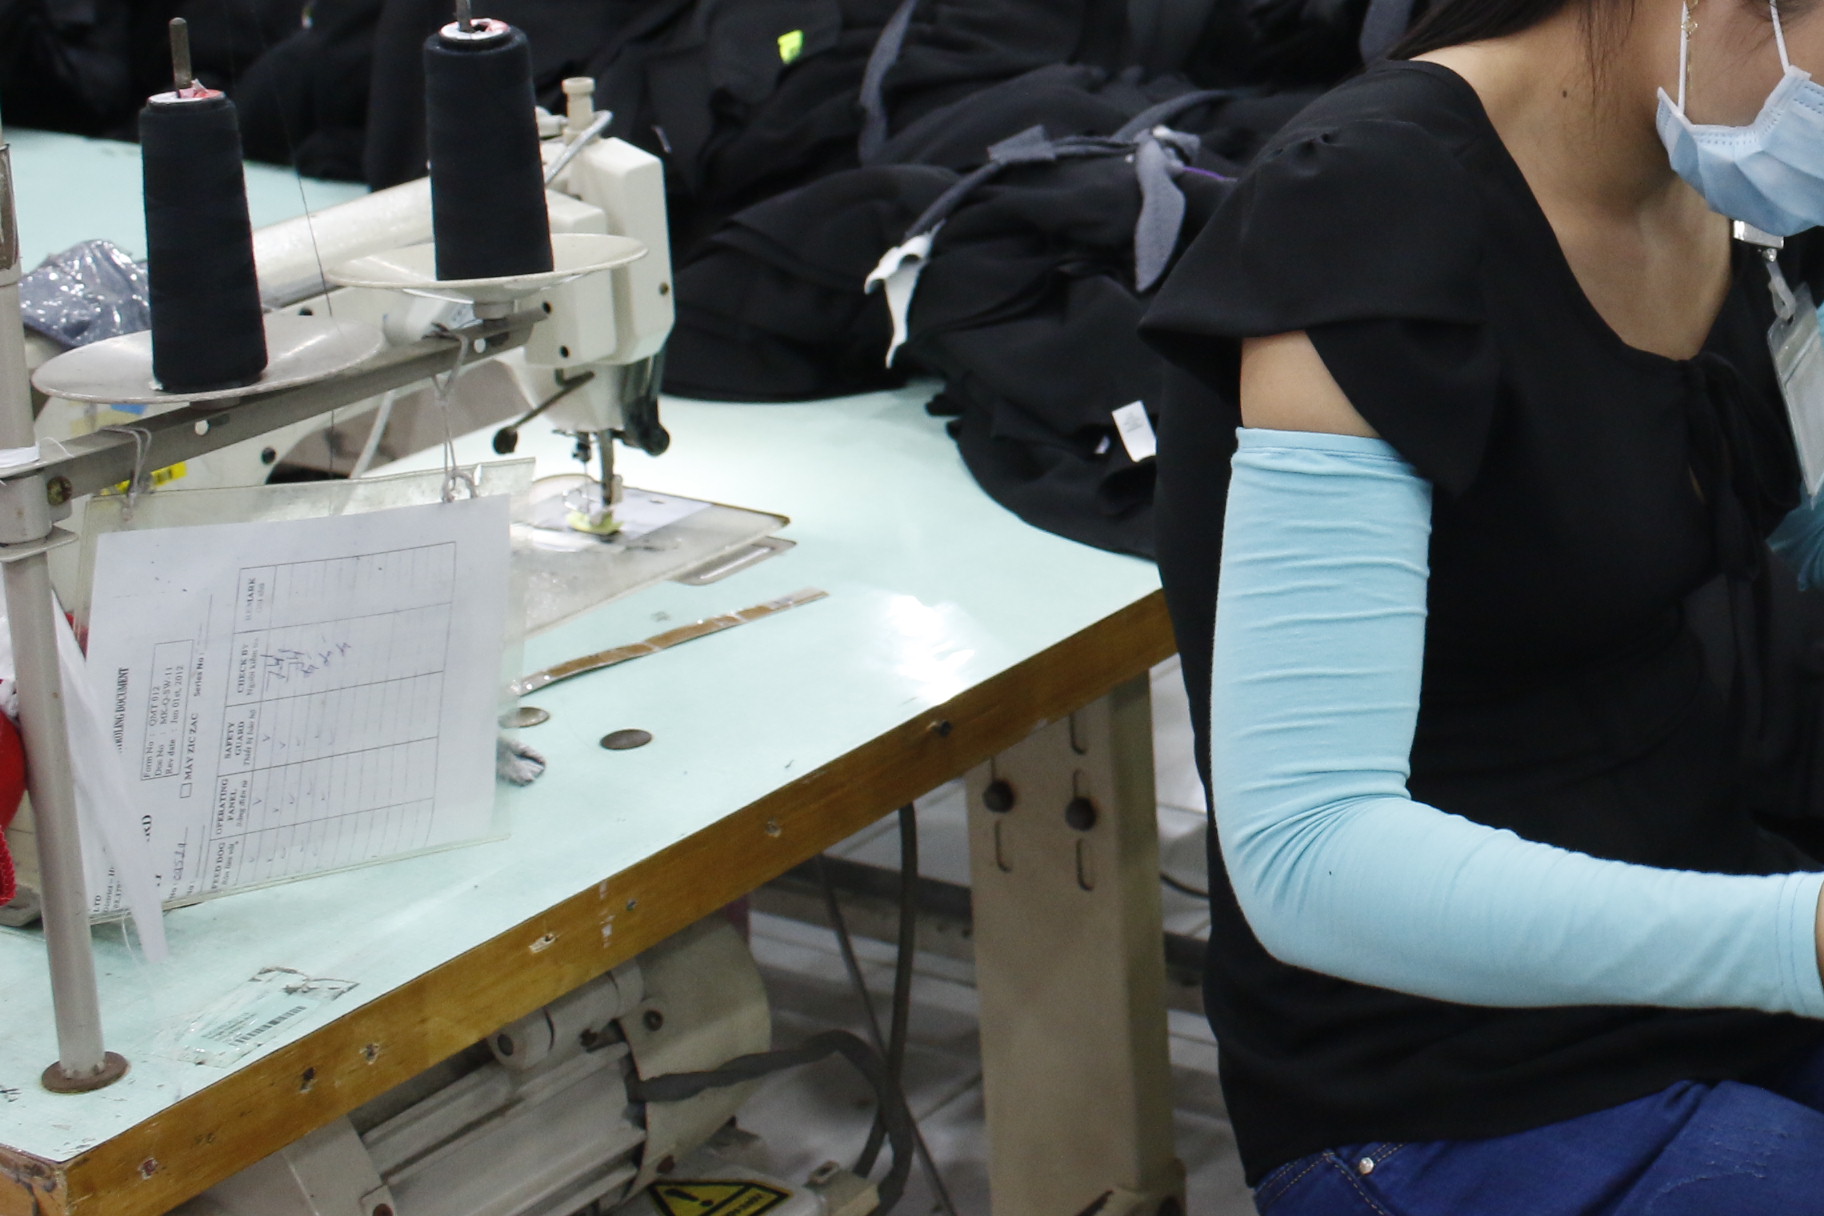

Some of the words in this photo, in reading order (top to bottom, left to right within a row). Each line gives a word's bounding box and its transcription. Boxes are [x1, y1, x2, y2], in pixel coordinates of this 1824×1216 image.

[196, 657, 204, 670] No
[175, 666, 184, 686] 2012
[193, 672, 203, 698] Series
[237, 658, 248, 694] CHECK
[115, 668, 129, 714] DOCUMENT
[148, 705, 159, 727] QMT
[170, 710, 179, 724] Jun
[189, 713, 199, 734] ZAC
[146, 741, 154, 754] No
[166, 739, 176, 756] date
[186, 736, 196, 754] ZIC
[224, 722, 235, 759] SAFETY
[235, 721, 245, 756] GUARD
[143, 756, 153, 778] Form
[165, 758, 175, 774] Rev
[216, 778, 229, 835] OPERATING
[227, 788, 238, 822] PANEL
[211, 866, 221, 889] FEED
[216, 842, 226, 864] DOG
